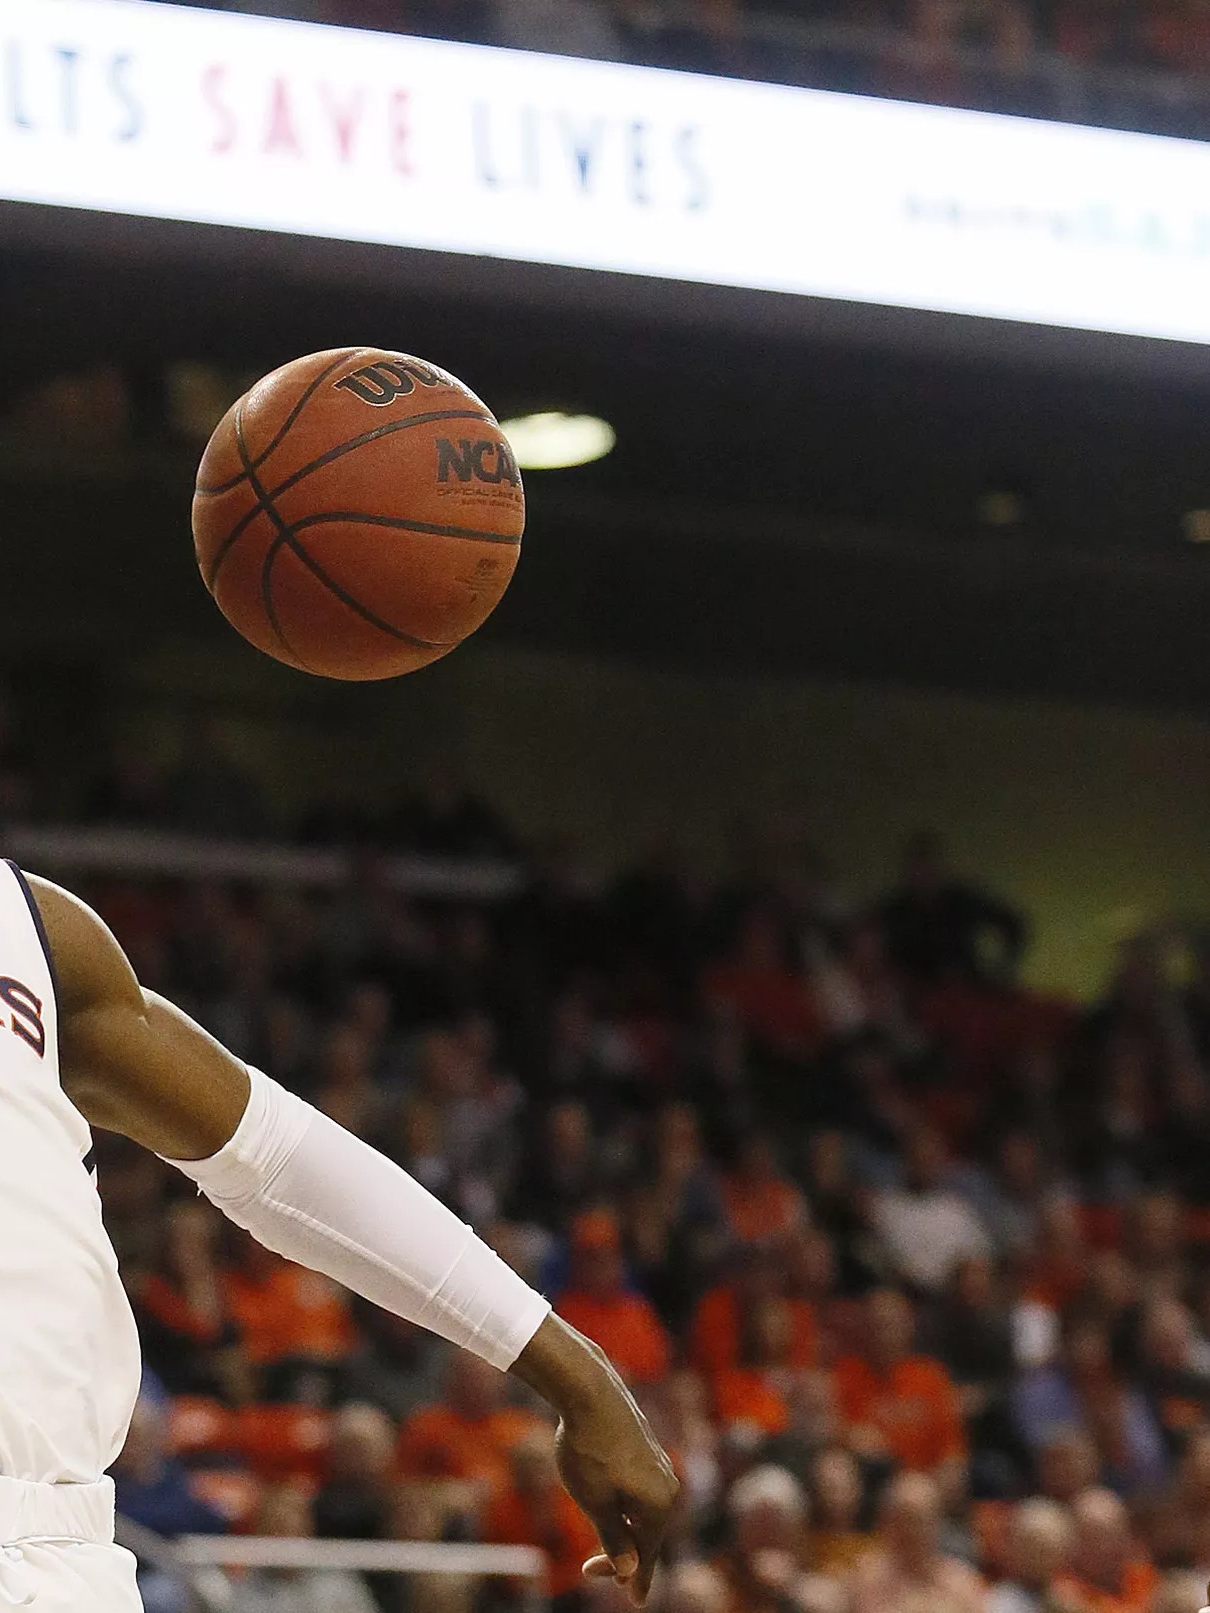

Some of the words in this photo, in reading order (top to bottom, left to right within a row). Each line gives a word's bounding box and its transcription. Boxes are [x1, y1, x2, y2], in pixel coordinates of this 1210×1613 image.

[199, 60, 416, 177] SAVE
[472, 99, 710, 212] LIVES
[436, 438, 522, 487] NCA
